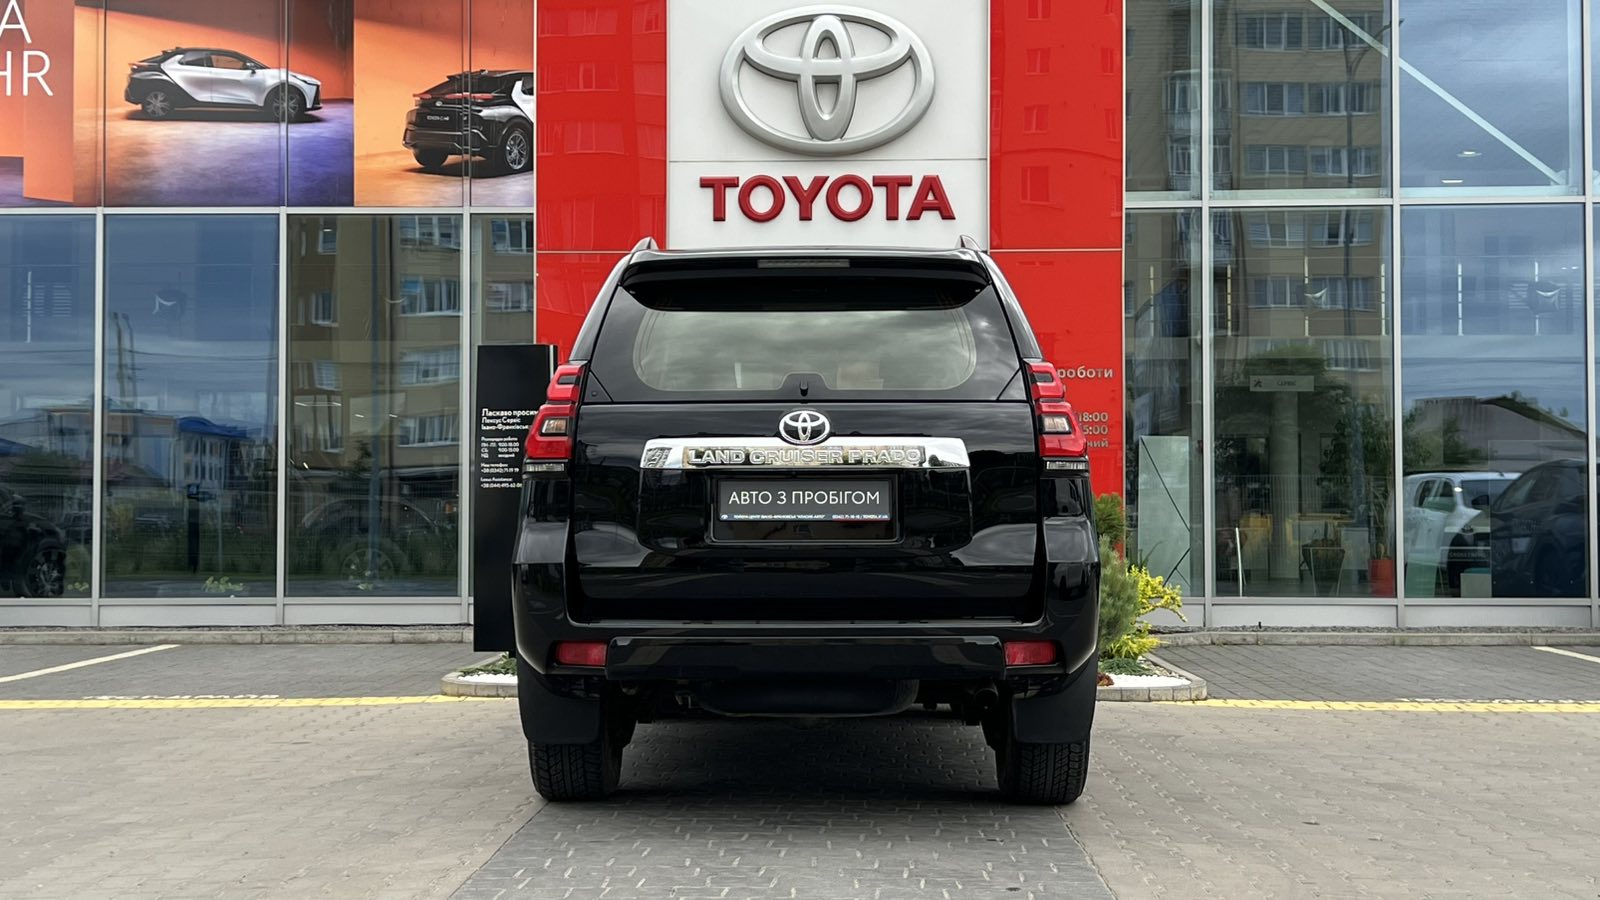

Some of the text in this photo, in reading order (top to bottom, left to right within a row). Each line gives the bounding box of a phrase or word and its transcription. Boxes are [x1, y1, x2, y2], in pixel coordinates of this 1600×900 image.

[699, 174, 956, 223] TOYOTA
[1083, 425, 1109, 435] 5:00
[688, 449, 921, 465] LAND CRUISER PRADO
[729, 491, 772, 505] АВТО
[792, 491, 880, 505] ПРОБІГОМ
